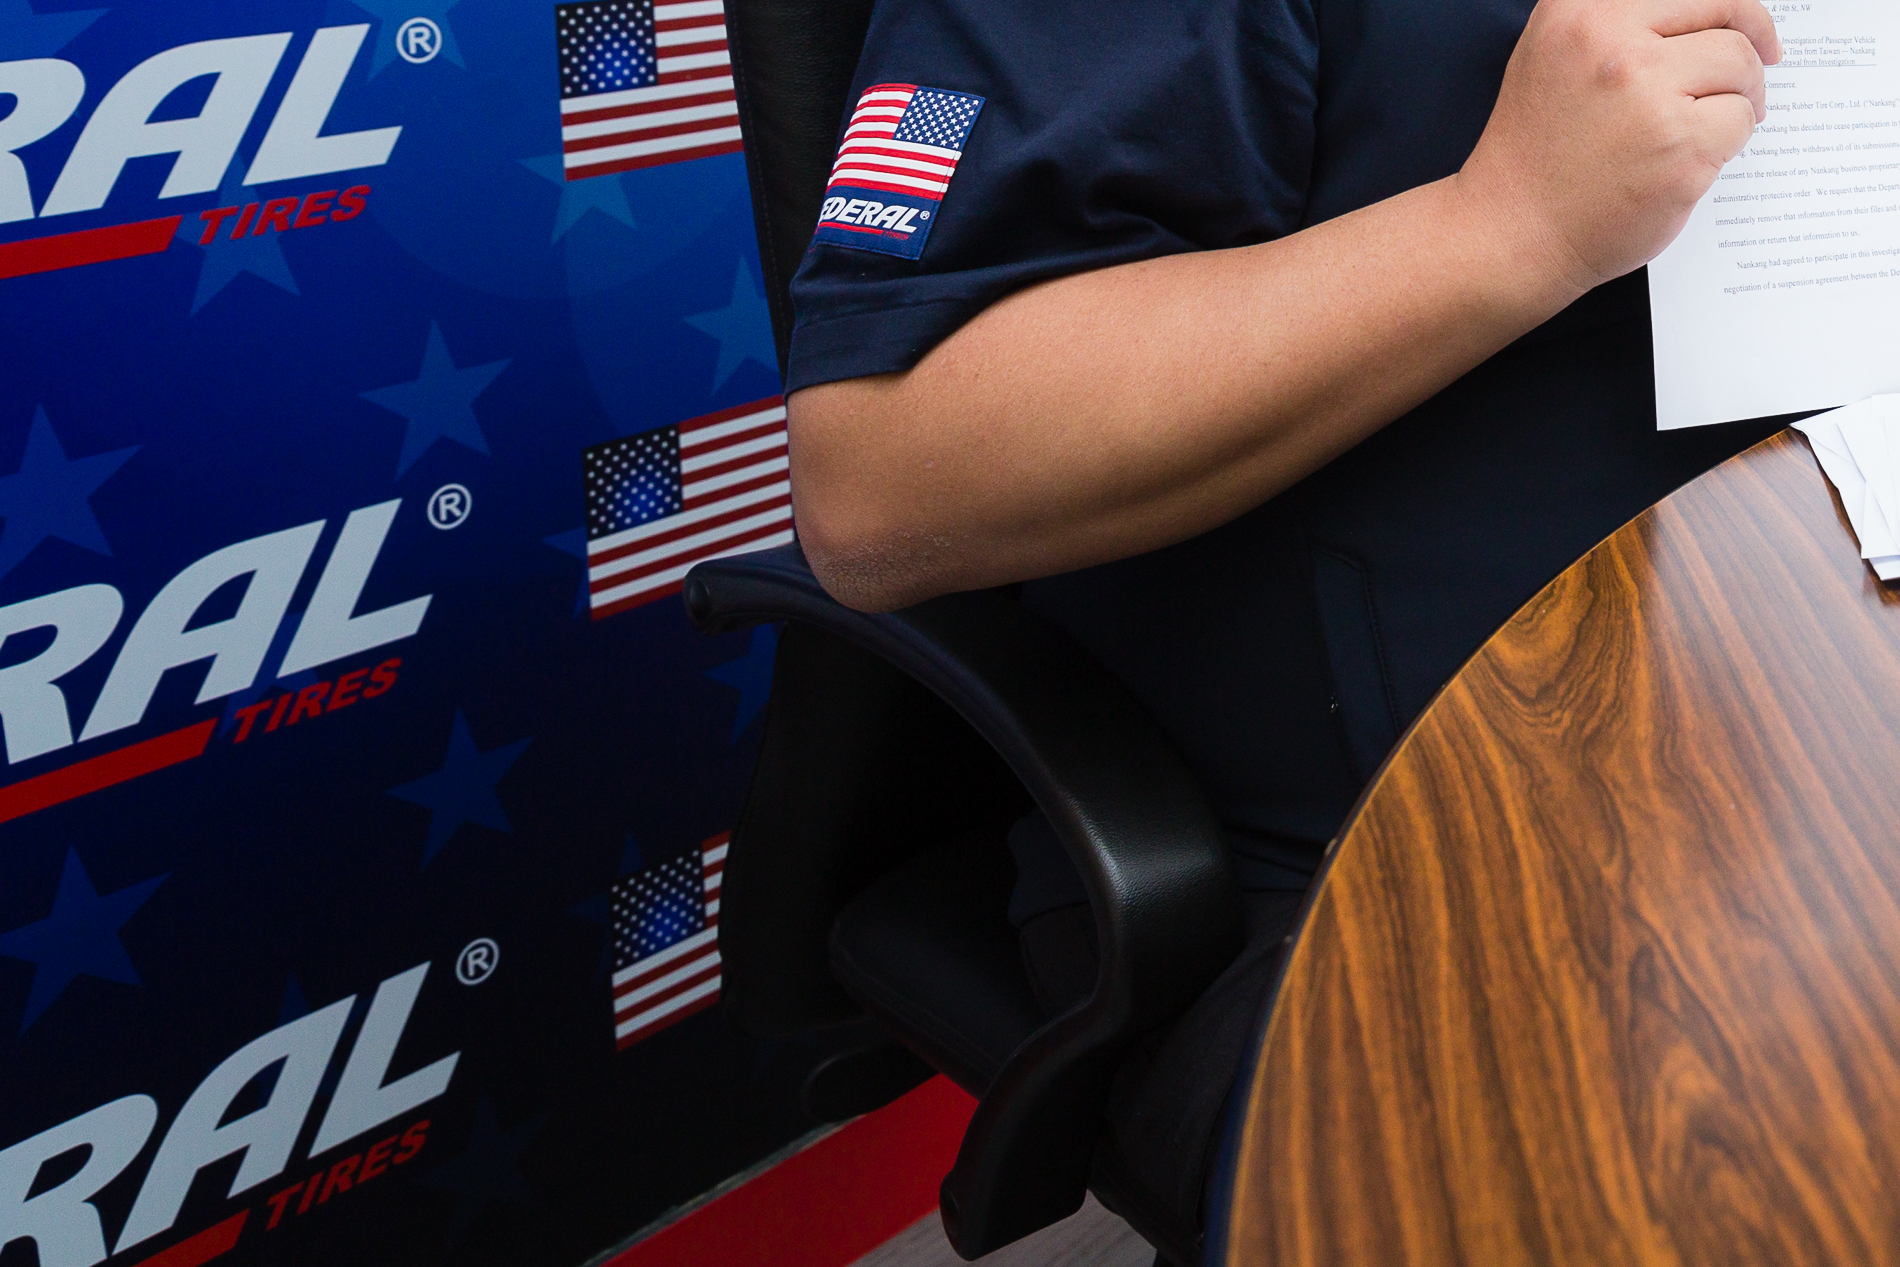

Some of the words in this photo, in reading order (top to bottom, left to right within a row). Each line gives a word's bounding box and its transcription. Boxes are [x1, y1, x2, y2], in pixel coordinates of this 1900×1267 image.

[1782, 37, 1817, 46] Investigation
[1817, 36, 1824, 44] of
[1824, 36, 1853, 45] Passenger
[1788, 47, 1803, 55] Tires
[1803, 47, 1818, 55] from
[1849, 47, 1876, 55] Nankang
[199, 184, 371, 246] TIRES
[1714, 216, 1755, 225] immediately
[1782, 212, 1796, 220] that
[1869, 205, 1884, 213] files
[1717, 239, 1757, 248] information
[1787, 234, 1801, 242] that
[1802, 232, 1841, 240] information
[1735, 261, 1768, 269] Nankang
[1768, 258, 1781, 266] had
[1782, 256, 1805, 266] agreed
[1813, 253, 1848, 263] participate
[1849, 250, 1857, 258] in
[1857, 249, 1870, 257] this
[1723, 283, 1762, 294] negotiation
[1762, 280, 1771, 289] of
[1777, 279, 1814, 288] suspension
[1815, 275, 1850, 285] agreement
[1849, 272, 1878, 280] between
[232, 657, 402, 744] TIRES
[265, 1119, 431, 1232] TIRES
